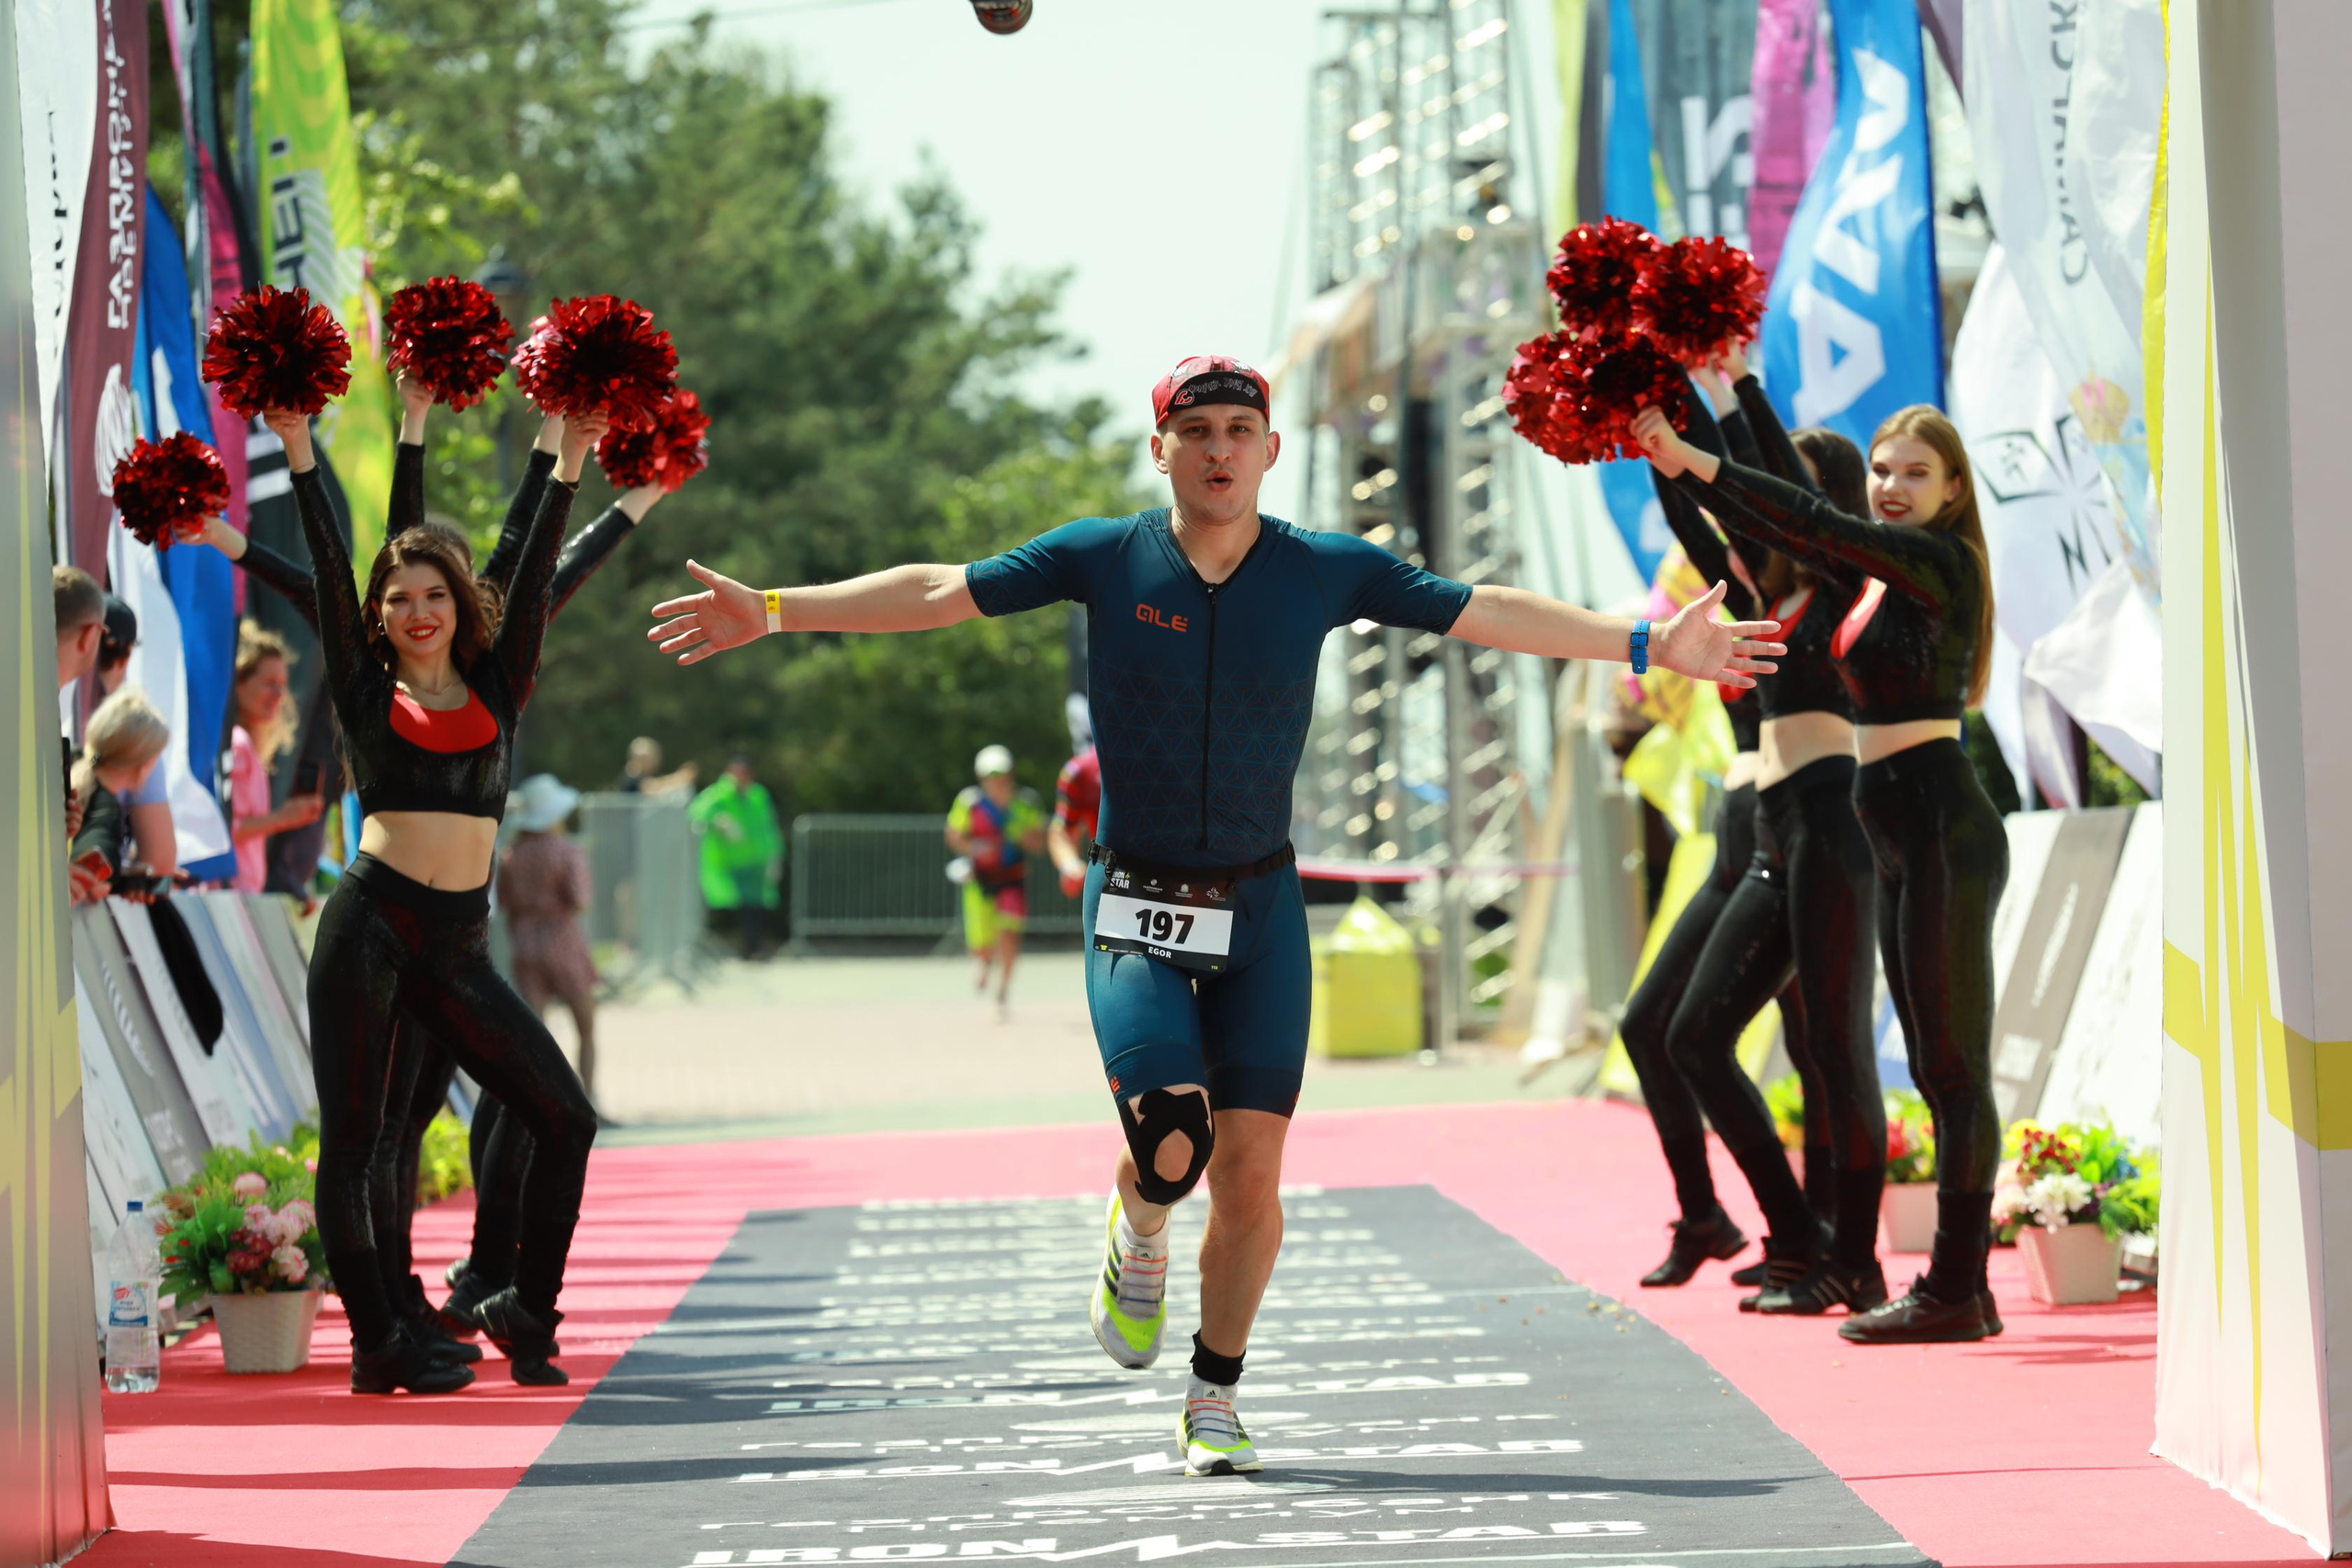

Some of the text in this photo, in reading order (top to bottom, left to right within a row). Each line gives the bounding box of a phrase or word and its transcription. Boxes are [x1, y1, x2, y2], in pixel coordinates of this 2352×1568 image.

[1110, 878, 1130, 888] STAR
[1135, 908, 1194, 944] 197
[1148, 946, 1172, 958] EGOR
[736, 1439, 1582, 1481] IRON STAR
[692, 1520, 1647, 1564] IRON STAR
